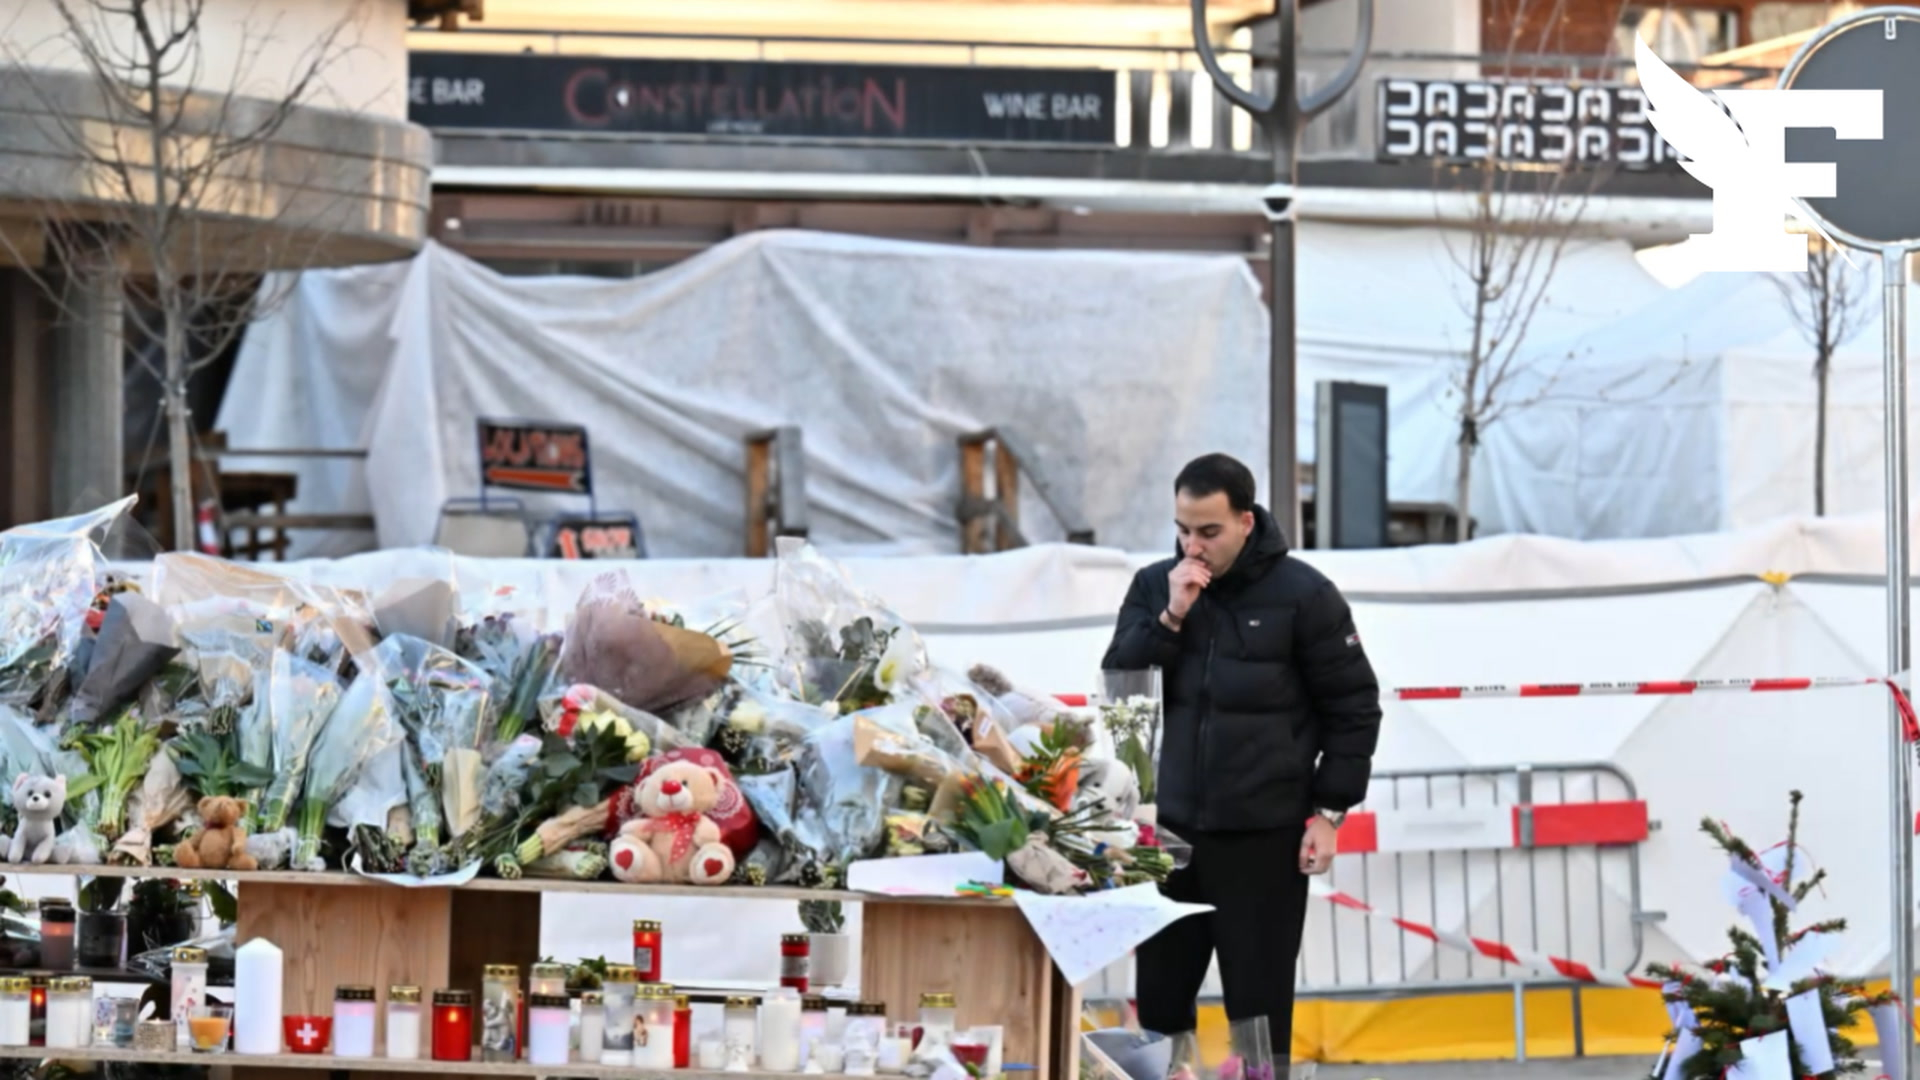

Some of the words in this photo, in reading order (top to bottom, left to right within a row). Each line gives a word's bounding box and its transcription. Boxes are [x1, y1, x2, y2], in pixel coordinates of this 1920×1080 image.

[432, 78, 484, 105] BAR
[983, 92, 1047, 120] WINE
[1050, 93, 1101, 121] BAR
